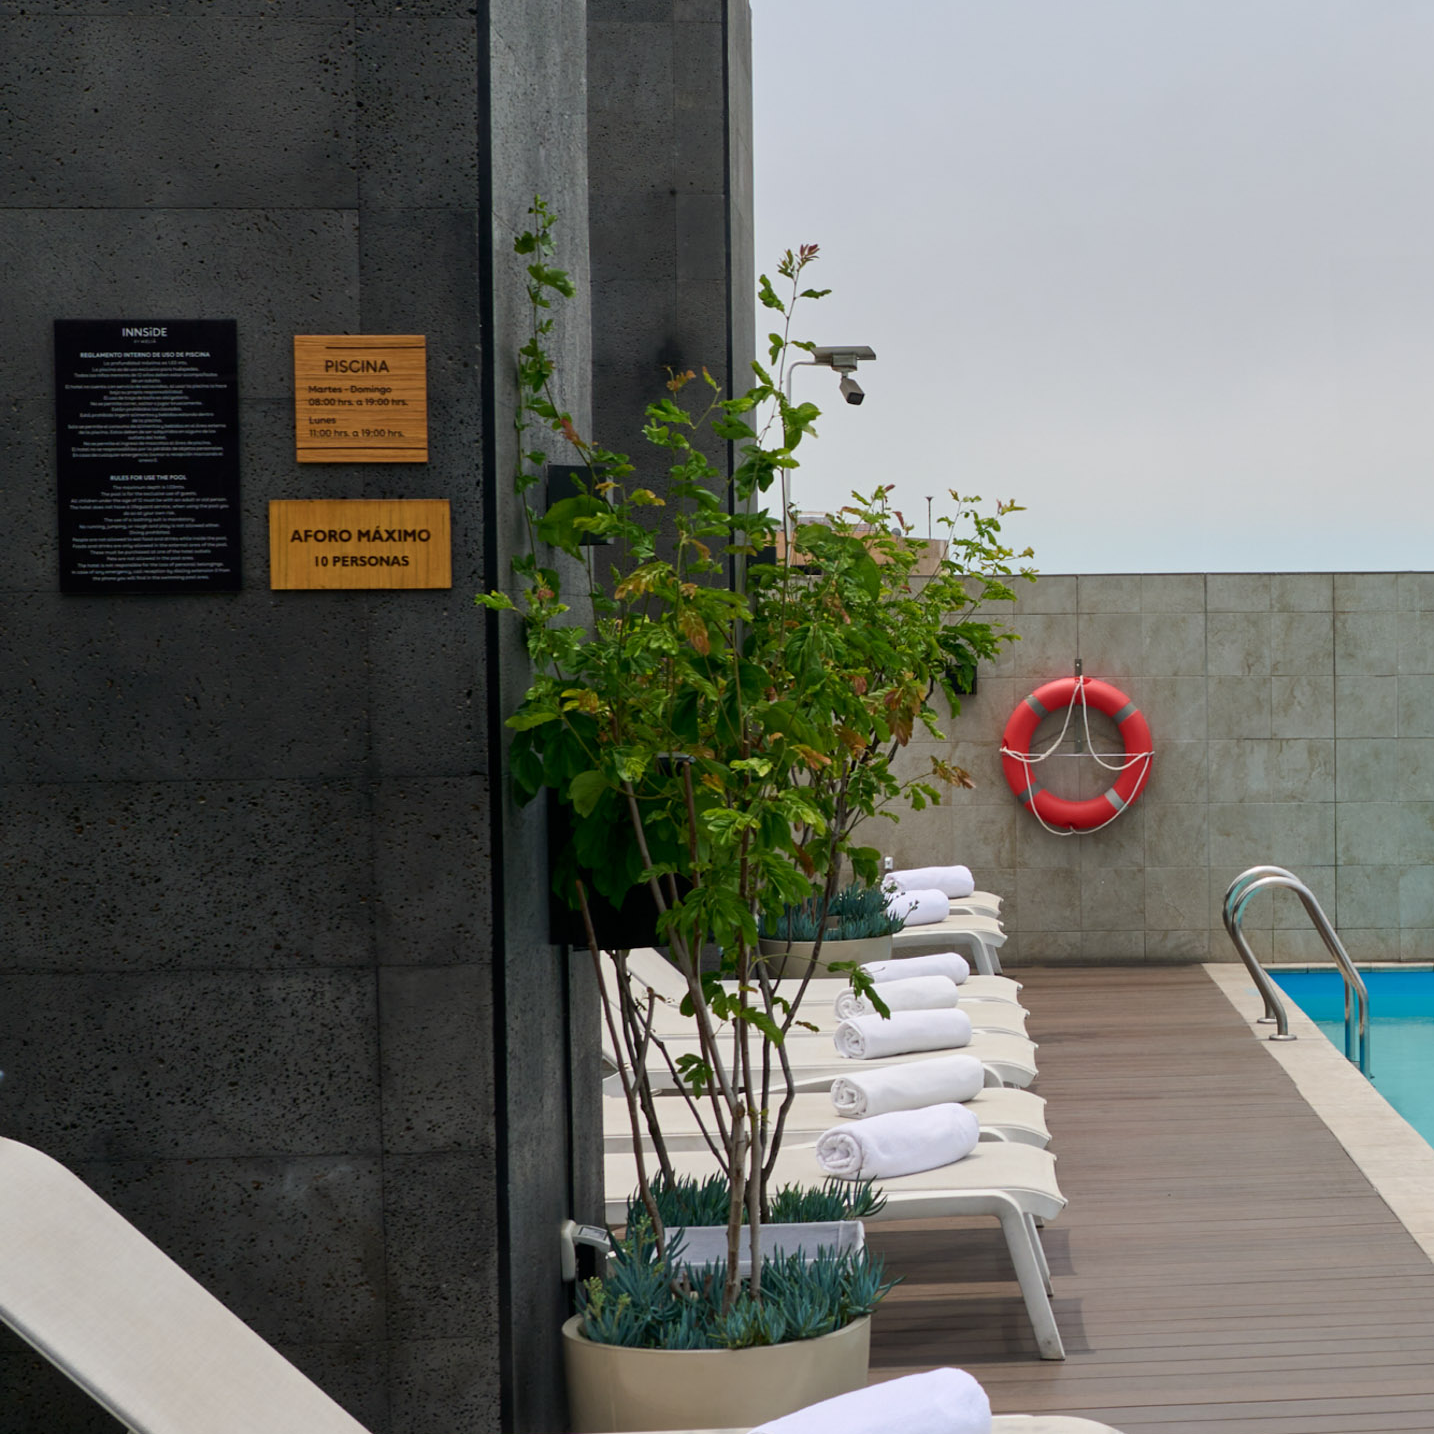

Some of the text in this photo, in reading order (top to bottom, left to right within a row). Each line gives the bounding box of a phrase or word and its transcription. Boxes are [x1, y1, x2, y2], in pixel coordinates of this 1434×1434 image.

[325, 360, 390, 373] PISCINA
[308, 385, 342, 394] Martes
[350, 385, 392, 395] Domingo
[337, 398, 354, 406] hrs.
[365, 398, 390, 406] 19:00
[391, 398, 408, 406] hrs.
[308, 416, 336, 424] Lunes
[333, 429, 350, 437] hrs.
[361, 429, 386, 437] 19:00
[387, 429, 405, 437] hrs.
[290, 525, 431, 542] AFORO MÁXIMO
[315, 555, 409, 567] 10 PERSONAS
